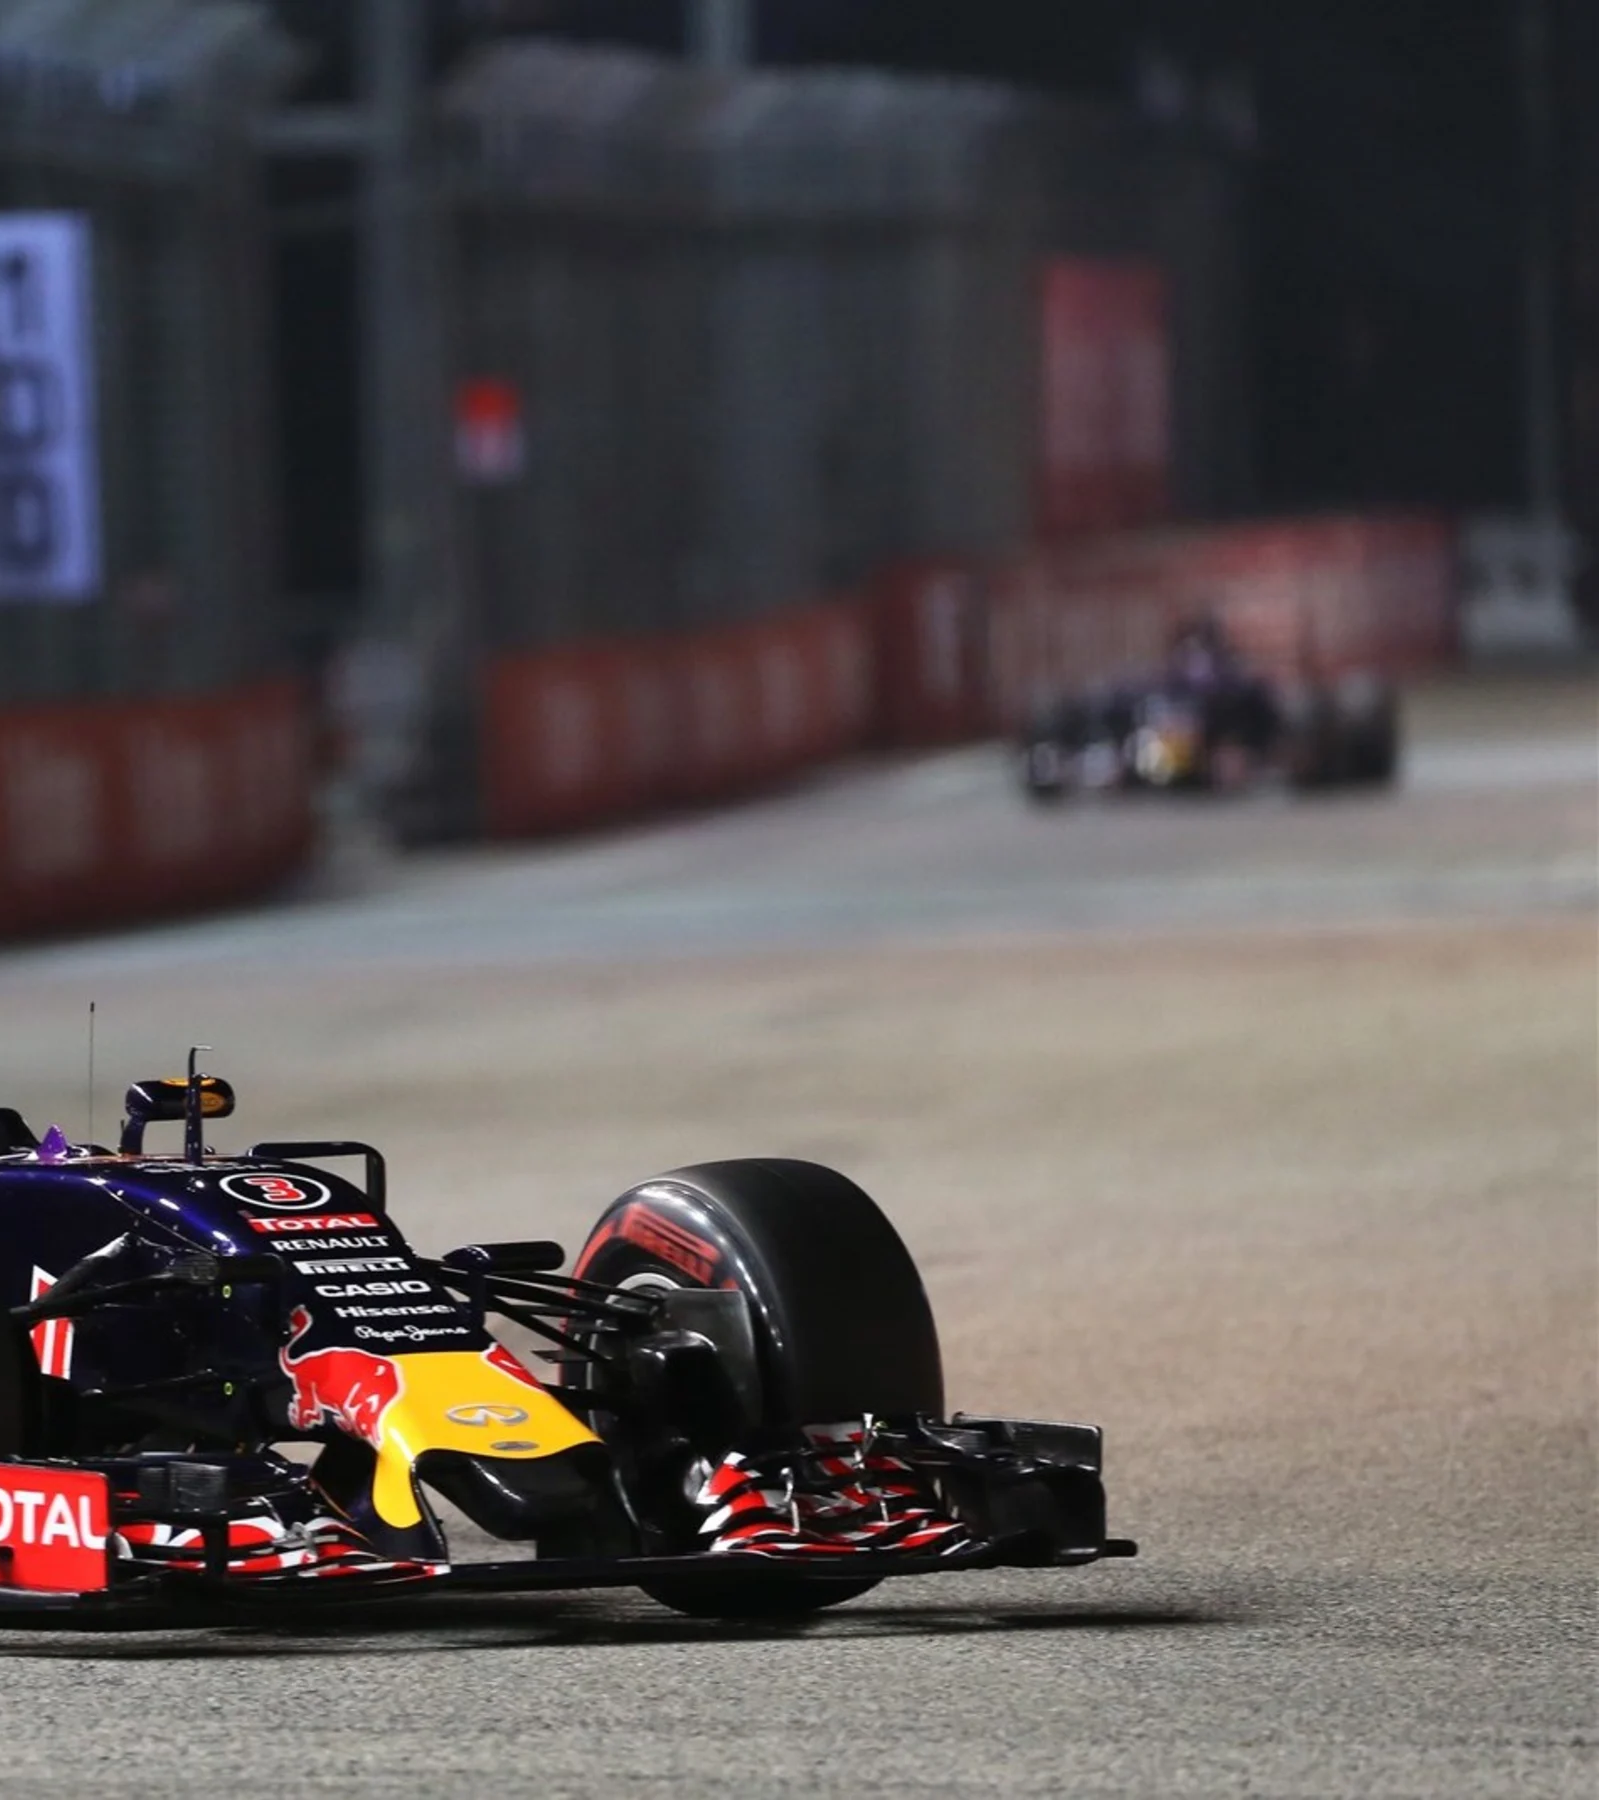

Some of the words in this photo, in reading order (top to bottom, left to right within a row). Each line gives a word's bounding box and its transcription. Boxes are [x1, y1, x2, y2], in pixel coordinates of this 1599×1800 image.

[244, 1177, 307, 1202] 3
[250, 1213, 378, 1231] TOTAL
[270, 1235, 388, 1251] RENAULT
[293, 1257, 410, 1275] PIRELLI
[314, 1280, 431, 1297] CASIO
[334, 1303, 452, 1318] Hisense
